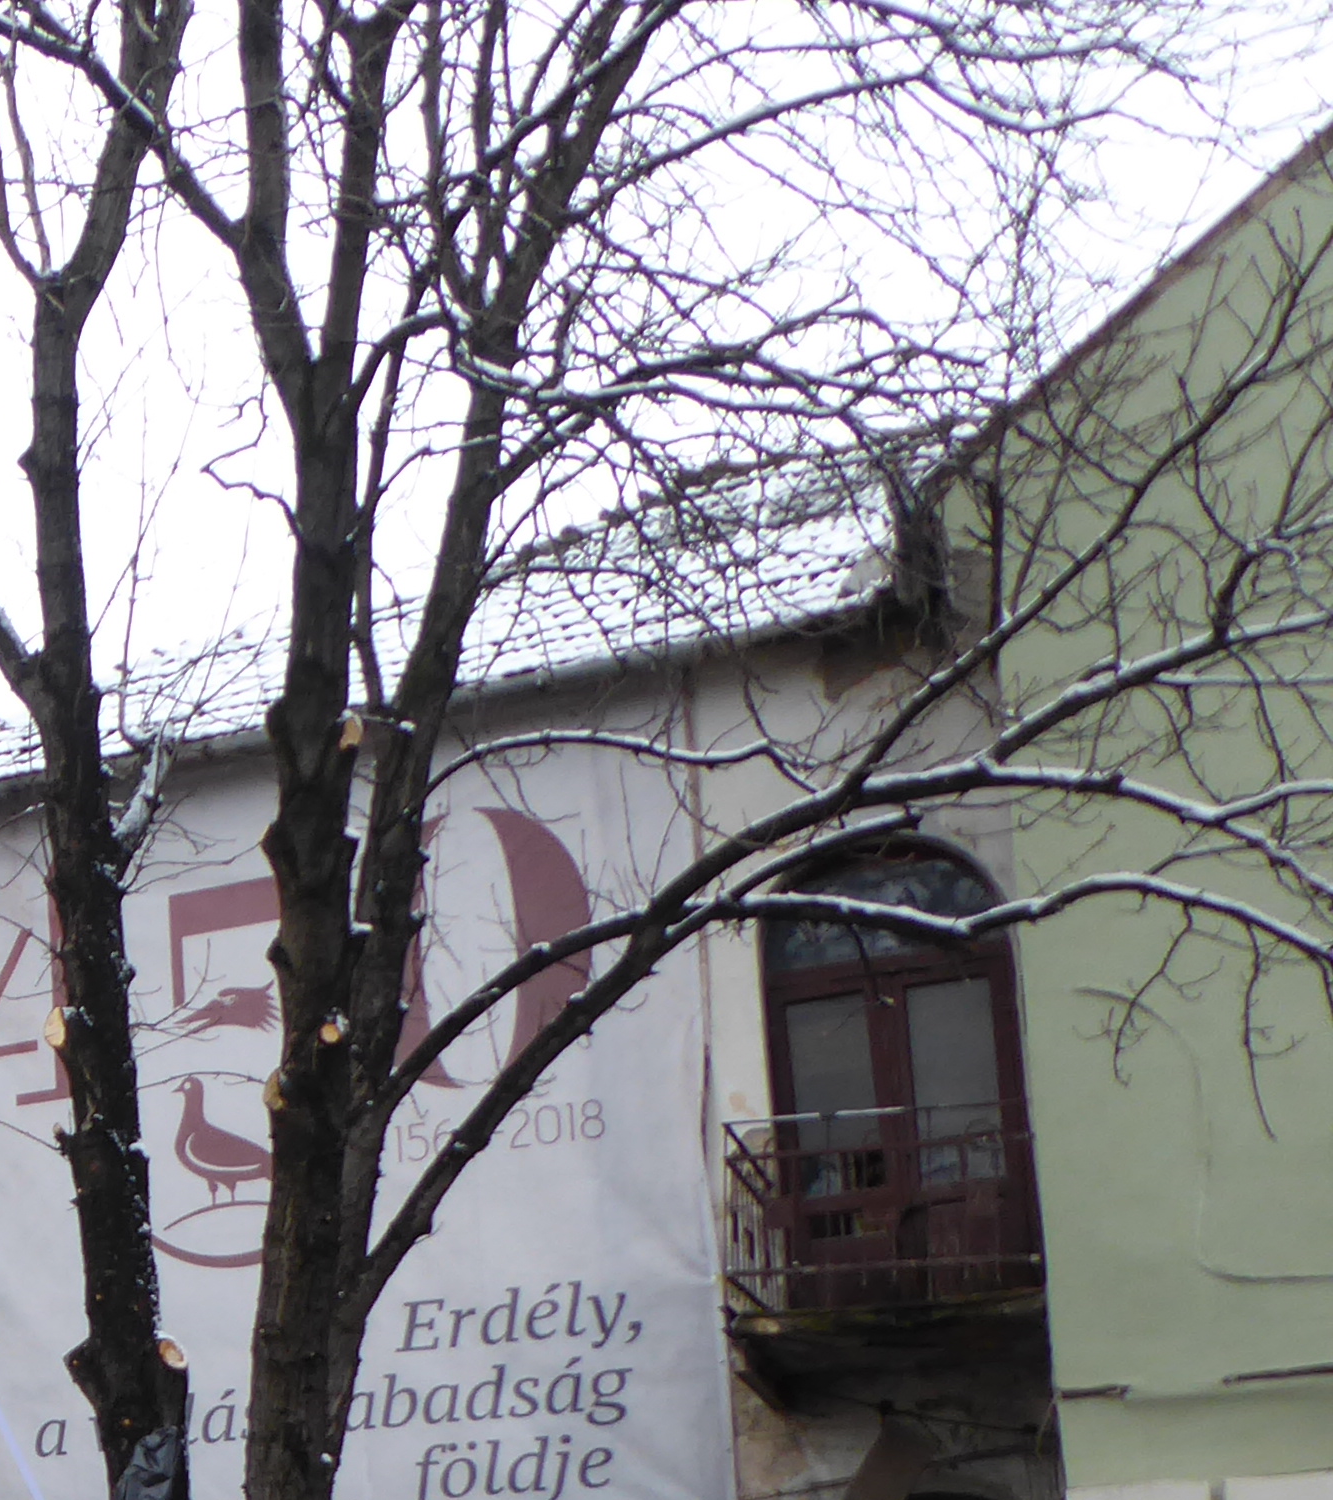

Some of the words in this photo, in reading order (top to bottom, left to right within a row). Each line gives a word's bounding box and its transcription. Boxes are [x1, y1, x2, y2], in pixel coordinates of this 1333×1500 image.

[395, 1098, 606, 1163] 156-2018
[395, 1279, 643, 1353] Erdély,
[35, 1418, 67, 1458] a
